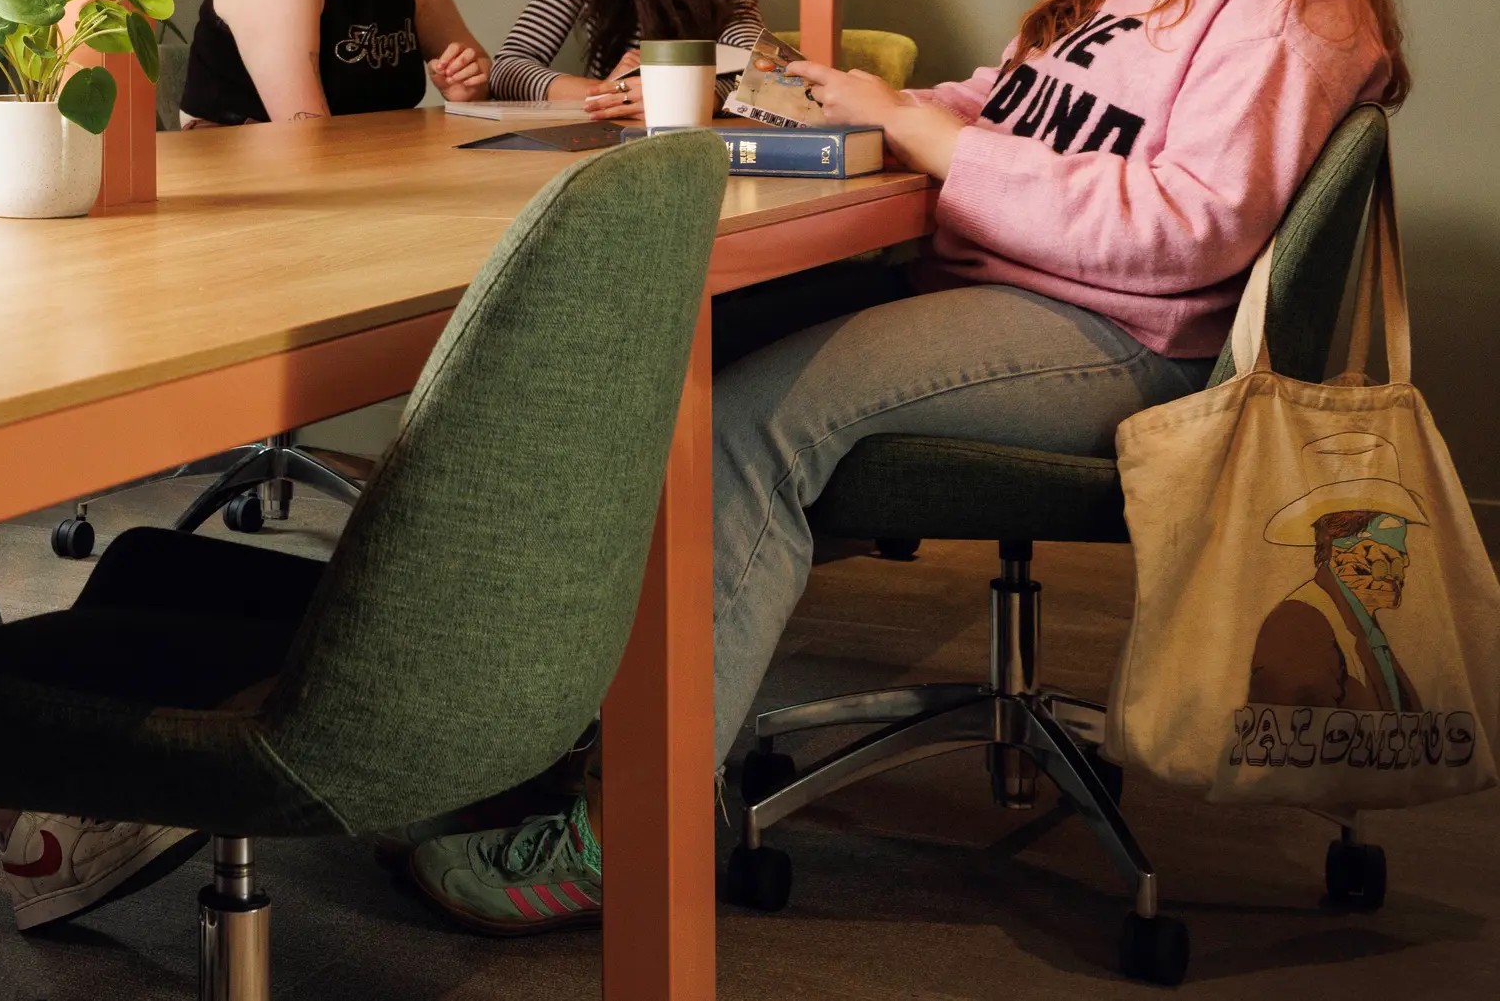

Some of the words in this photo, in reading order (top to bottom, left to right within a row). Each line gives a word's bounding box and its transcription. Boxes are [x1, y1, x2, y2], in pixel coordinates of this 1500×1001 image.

[750, 107, 786, 128] ONE-PUNCH
[981, 59, 1145, 160] OUND
[821, 145, 831, 164] BCA
[1229, 705, 1476, 771] PALOMINO
